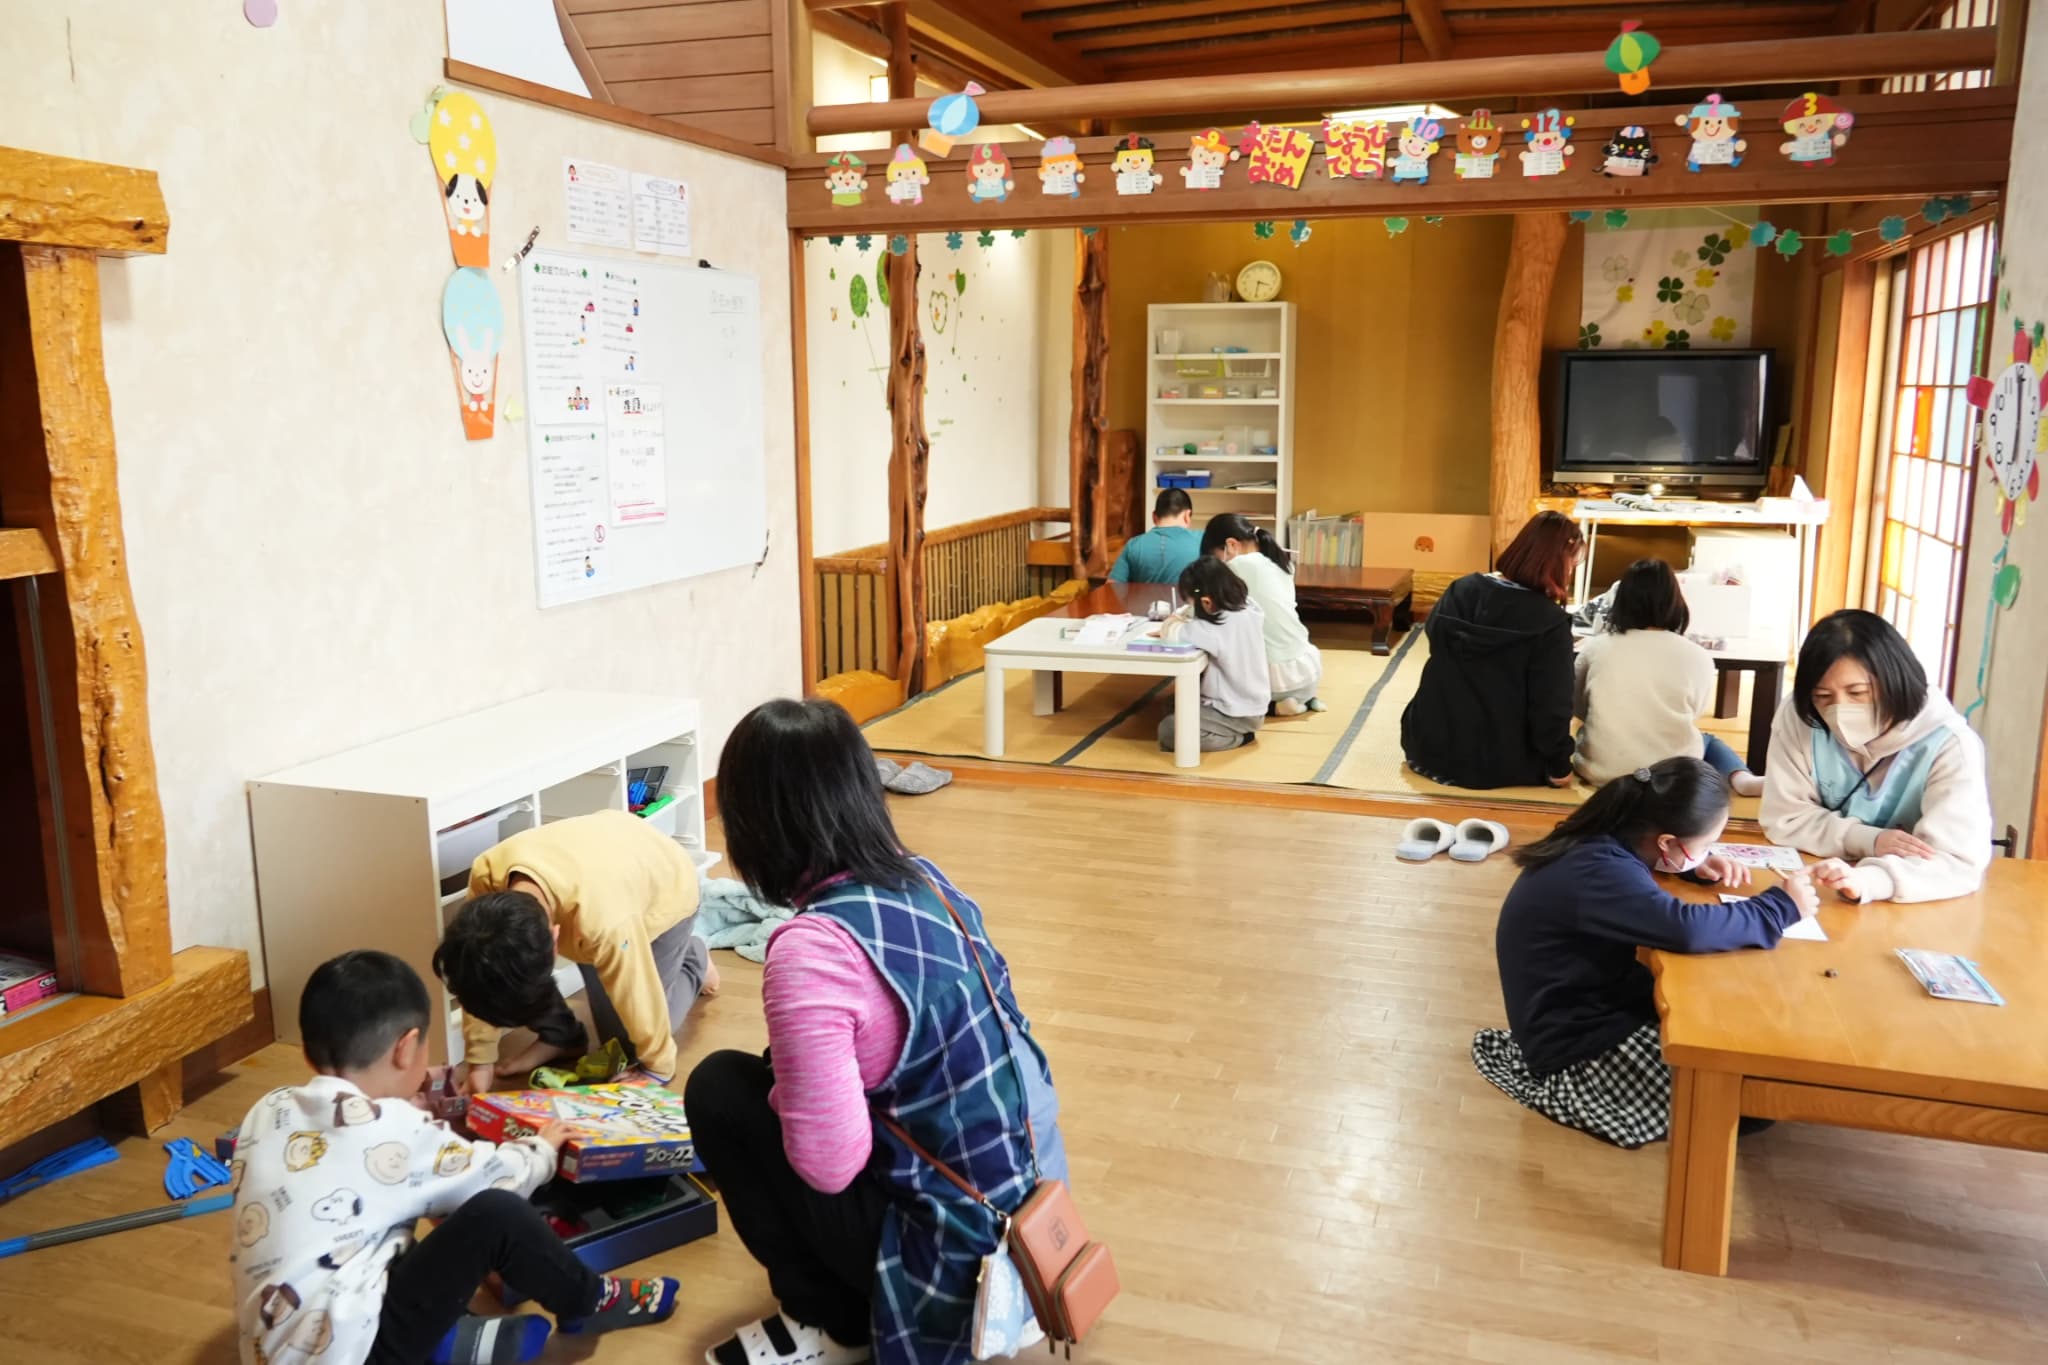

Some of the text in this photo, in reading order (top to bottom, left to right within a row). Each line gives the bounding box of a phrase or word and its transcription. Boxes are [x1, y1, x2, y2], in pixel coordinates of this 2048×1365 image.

[1705, 93, 1721, 116] 2
[1803, 92, 1818, 116] 3
[1415, 117, 1440, 141] 10
[1475, 110, 1489, 128] 11
[1536, 108, 1561, 132] 12
[1207, 130, 1220, 147] 9
[982, 143, 993, 159] 6
[1248, 151, 1296, 188] おめ
[1990, 413, 1997, 436] 9
[1995, 441, 2003, 465] 8
